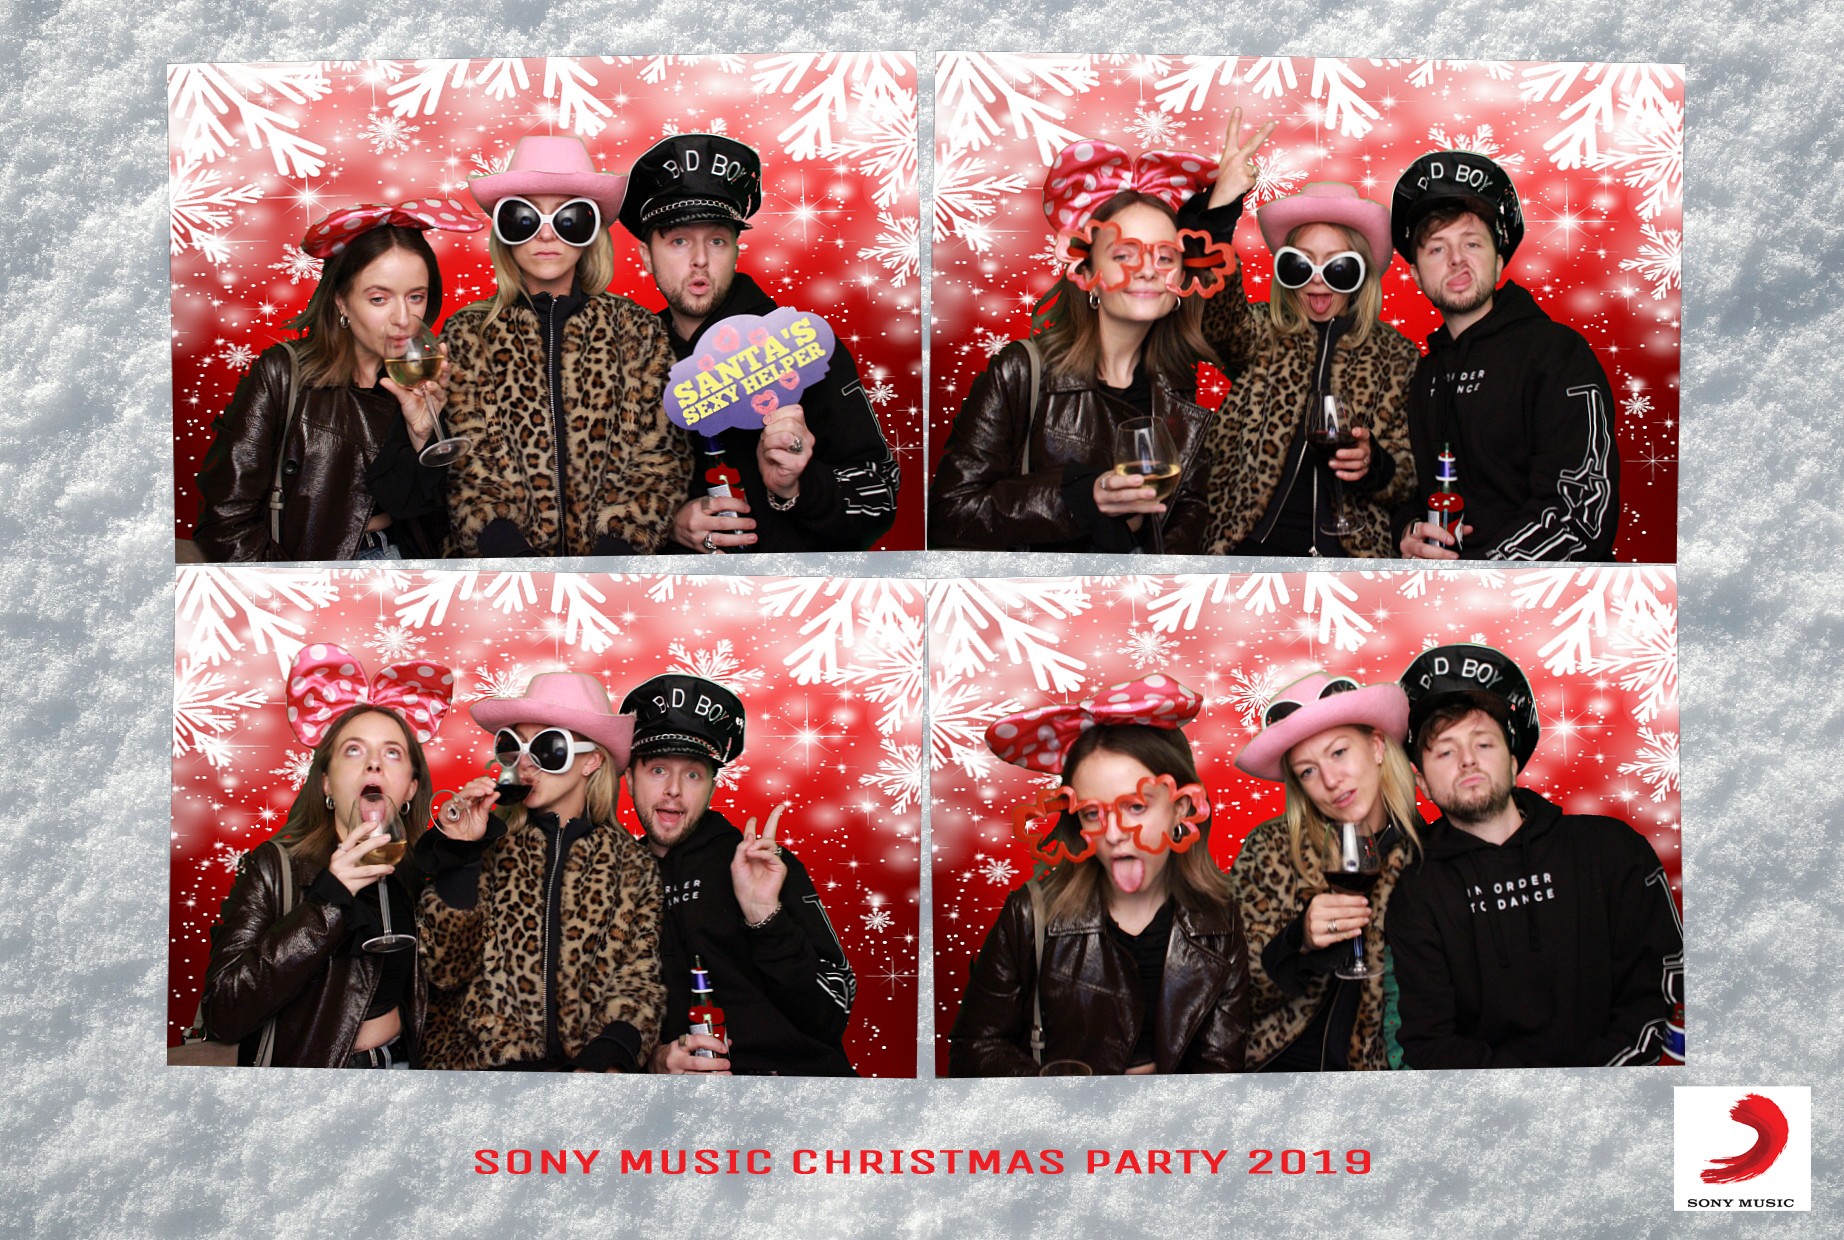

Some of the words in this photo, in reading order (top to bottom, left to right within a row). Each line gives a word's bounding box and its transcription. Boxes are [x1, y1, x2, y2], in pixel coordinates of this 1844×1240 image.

[662, 150, 700, 179] BD
[1416, 162, 1444, 191] BD
[1455, 164, 1494, 192] BOY
[673, 317, 817, 409] SANTA'S
[682, 383, 740, 426] SEXY
[741, 341, 826, 396] HELPER
[1419, 656, 1450, 691] BD
[1461, 658, 1504, 689] BOY
[652, 688, 686, 714] BD
[695, 694, 730, 725] BOY
[1493, 872, 1552, 894] ORDER
[1497, 887, 1555, 911] DANCE
